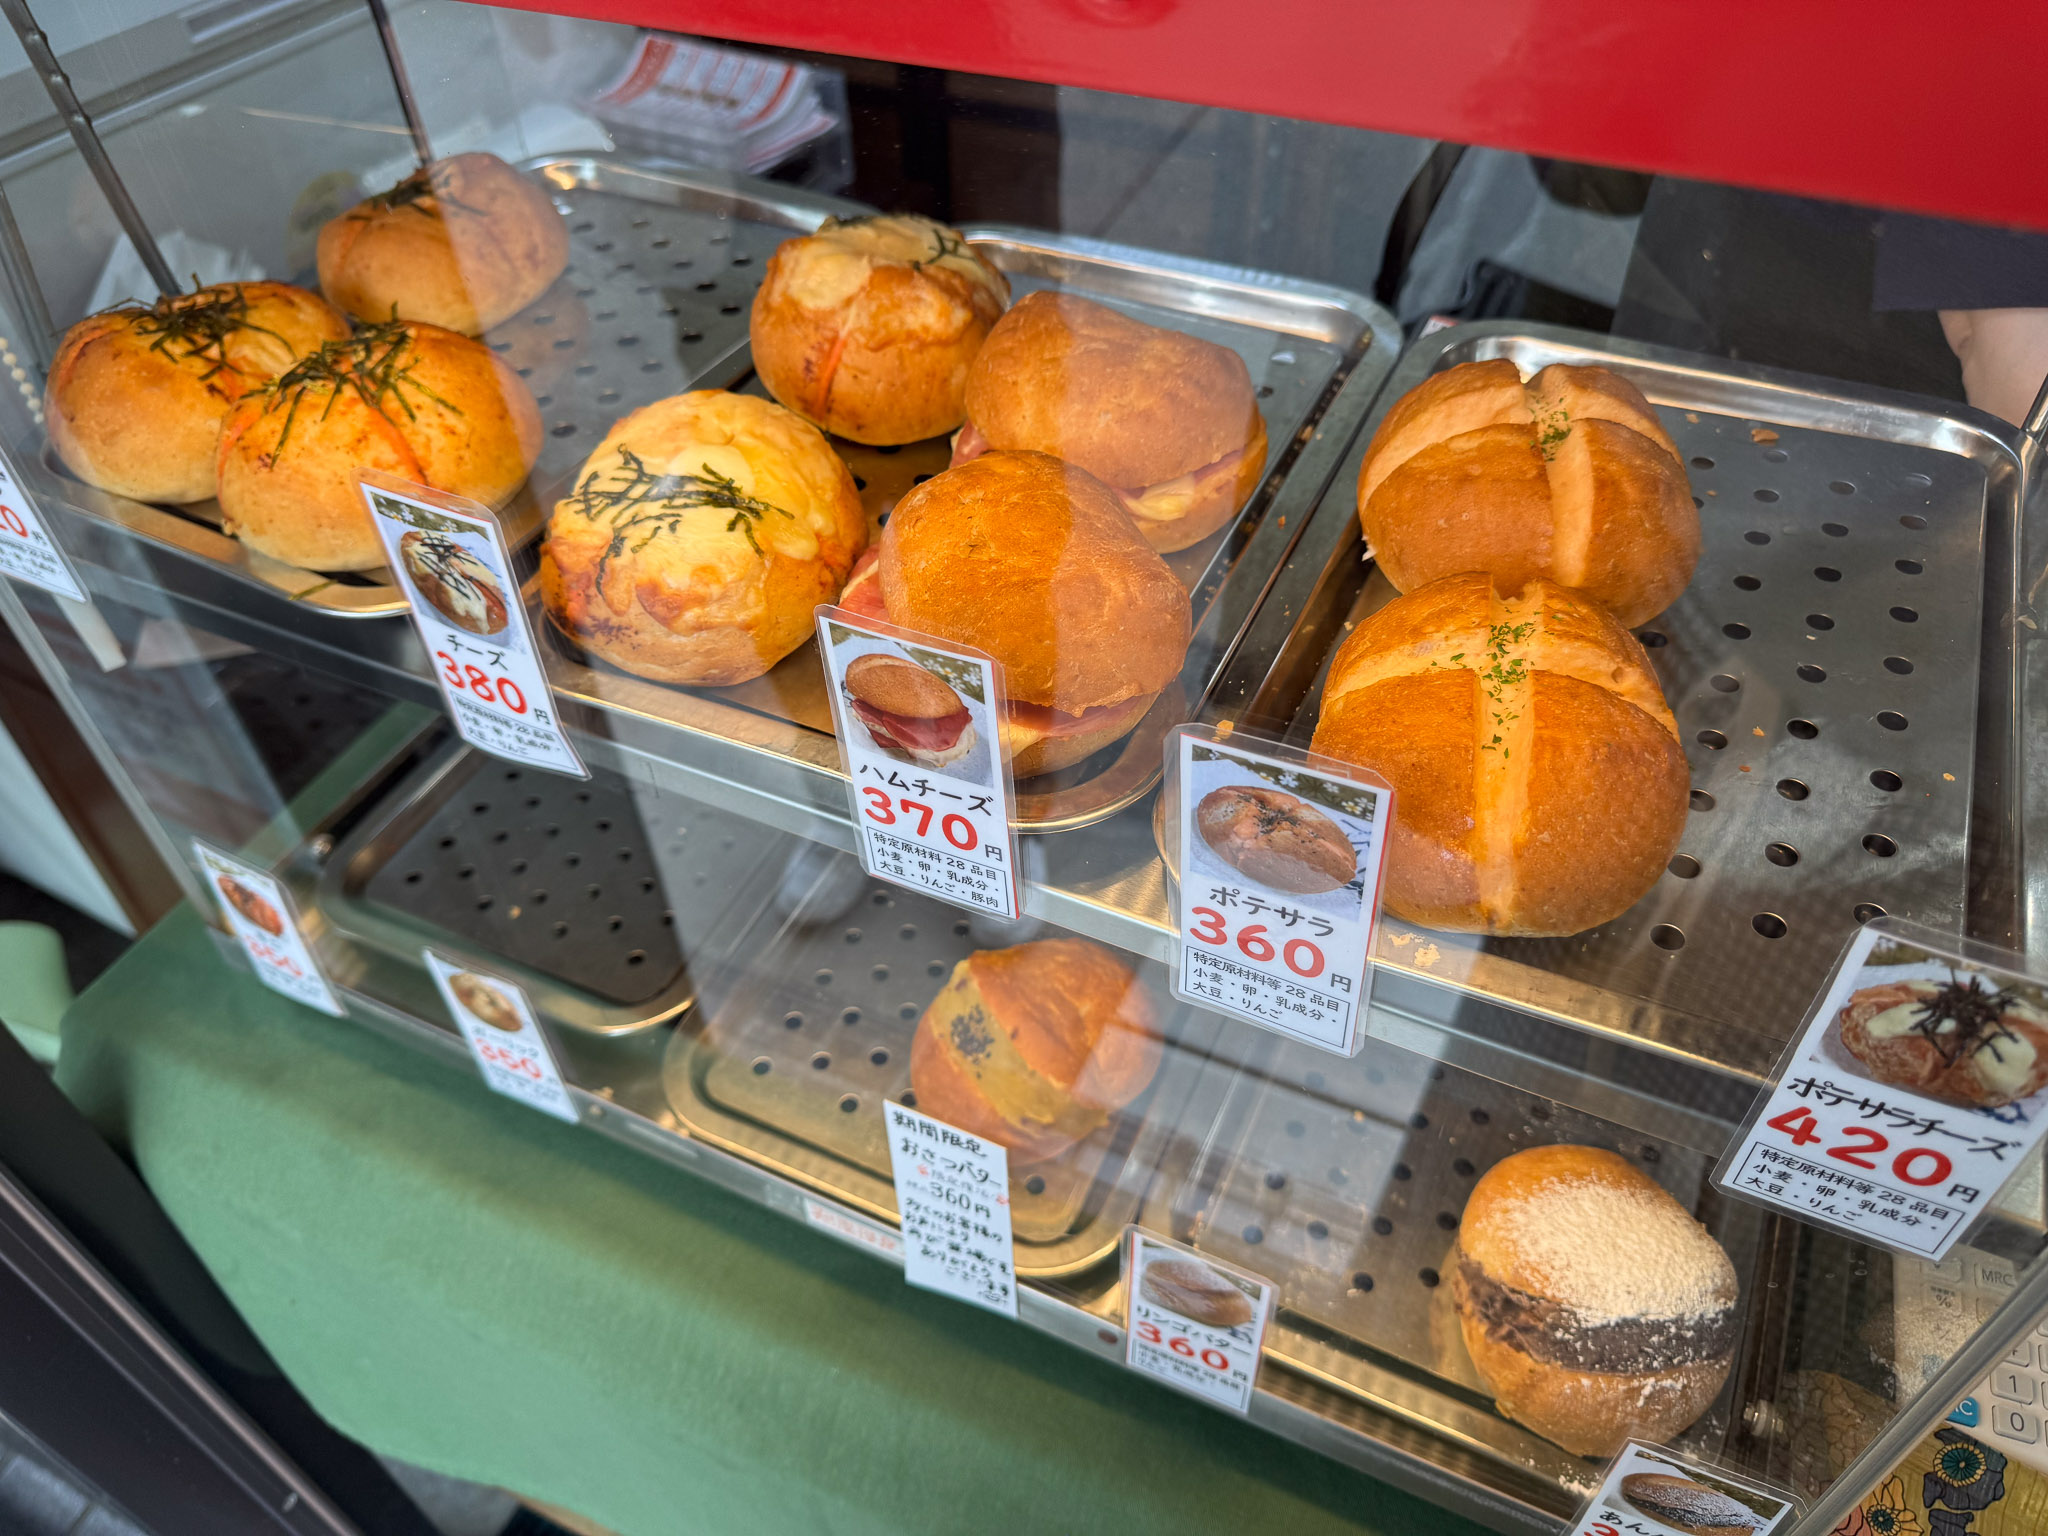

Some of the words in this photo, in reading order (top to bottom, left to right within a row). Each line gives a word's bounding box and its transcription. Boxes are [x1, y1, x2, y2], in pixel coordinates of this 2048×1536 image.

[446, 634, 509, 671] チーズ
[859, 764, 994, 817] ハムチーズ
[1209, 886, 1334, 937] ポテサラ
[1192, 981, 1283, 1020] 大豆・りんご
[893, 1110, 987, 1158] 期間限定
[1786, 1076, 2023, 1161] ポテサラチーズ
[1744, 1176, 1865, 1222] 大豆・りんご
[1981, 1268, 2016, 1288] MRC
[2008, 1374, 2017, 1394] 1
[1599, 1510, 1664, 1536] あん
